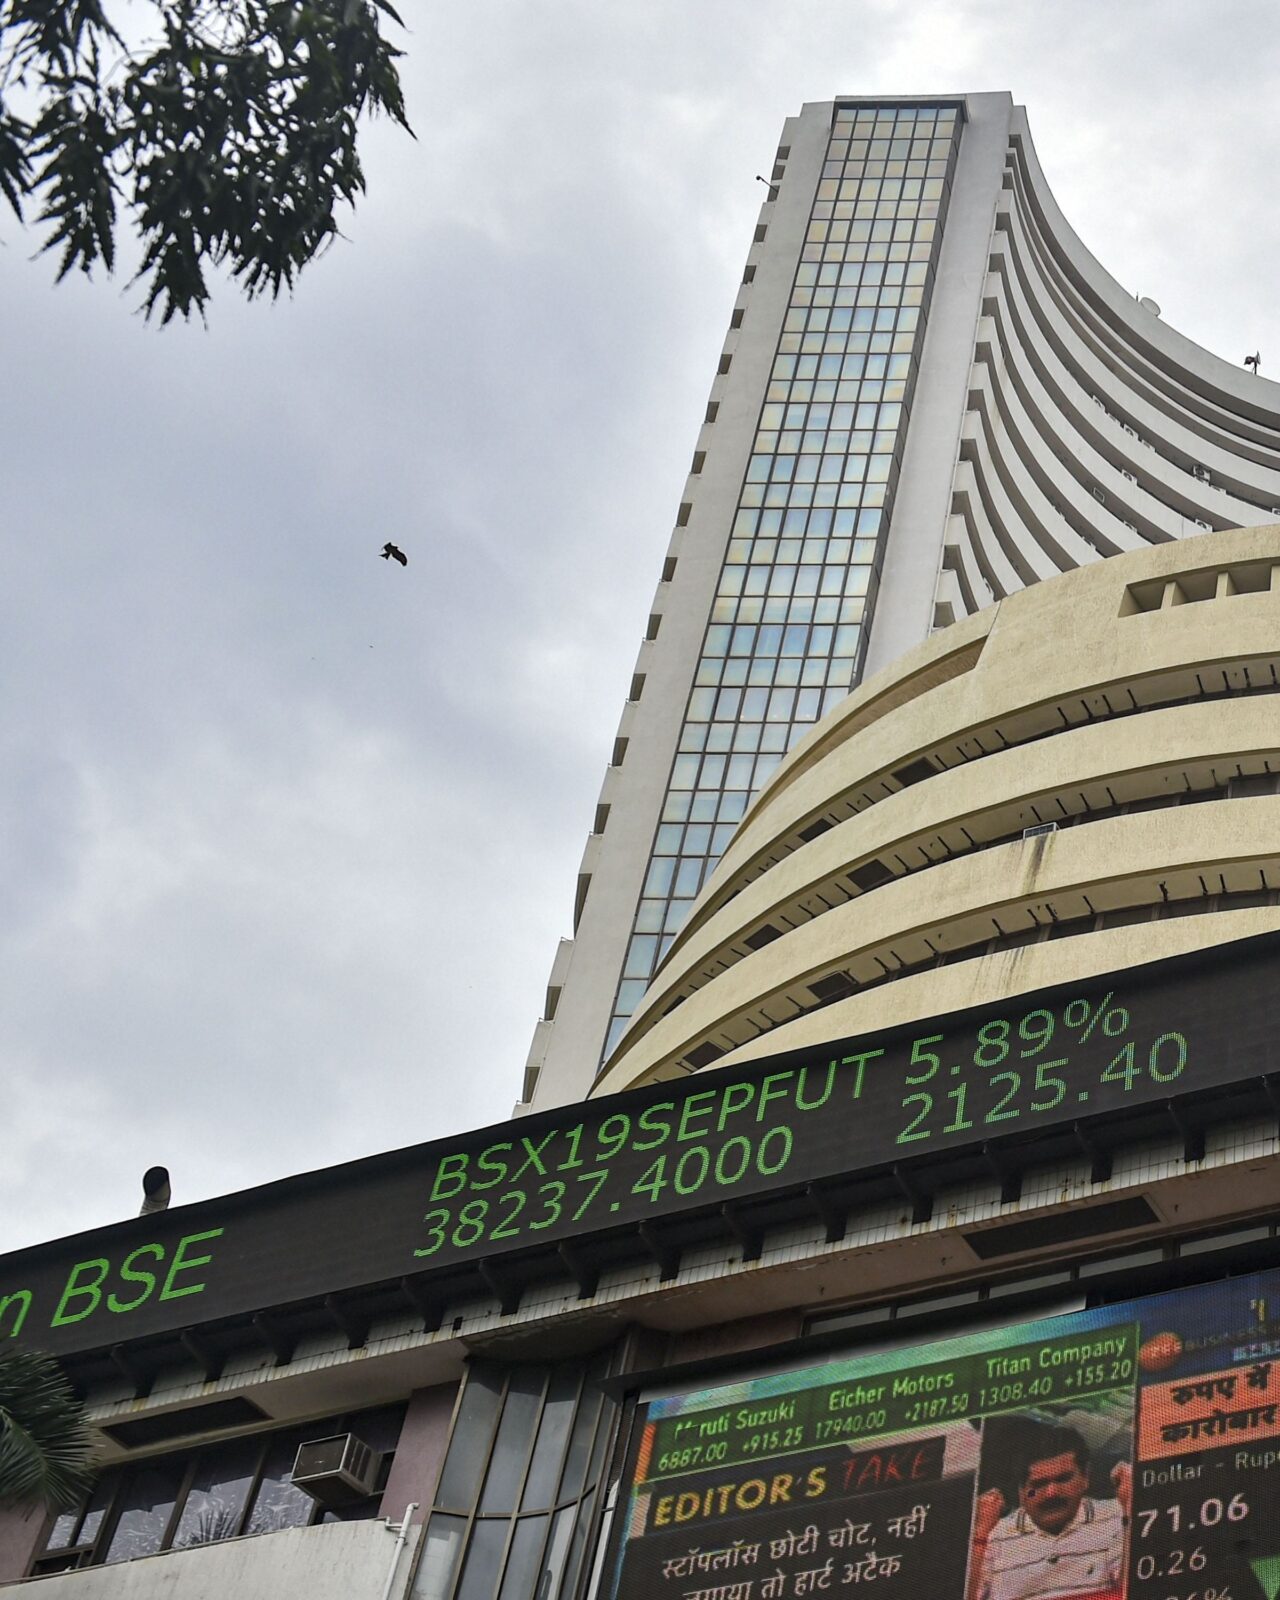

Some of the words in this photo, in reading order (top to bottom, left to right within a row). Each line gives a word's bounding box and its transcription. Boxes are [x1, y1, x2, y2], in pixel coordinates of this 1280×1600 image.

[428, 1048, 886, 1203] BSX19SEPFUT
[904, 990, 1131, 1087] 5.89%
[413, 1124, 795, 1258] 38237.4000
[895, 1031, 1188, 1145] 2125.40
[50, 1227, 225, 1328] BSE
[986, 1357, 1031, 1379] Titan
[1039, 1336, 1127, 1368] Company
[828, 1384, 886, 1412] Eicher
[892, 1371, 955, 1398] Motors
[978, 1376, 1052, 1408] 1308.40
[1064, 1359, 1132, 1389] +155.20
[674, 1412, 731, 1440] ruti
[735, 1401, 796, 1430] Suzuki
[815, 1409, 887, 1440] 17940.00
[904, 1392, 970, 1422] +2187.50
[1160, 1402, 1279, 1442] कारोबार
[657, 1441, 728, 1472] 6887.00
[1141, 1463, 1204, 1489] Dollar
[653, 1465, 828, 1527] EDITOR'S
[1137, 1492, 1250, 1538] 71.06
[661, 1538, 762, 1580] स्टॉपलॉस
[769, 1523, 821, 1560] छोटी
[886, 1503, 932, 1539] नहीं
[1136, 1545, 1207, 1581] 0.26
[760, 1567, 787, 1599] तो
[793, 1556, 835, 1596] हार्ट
[840, 1550, 903, 1585] अटैक
